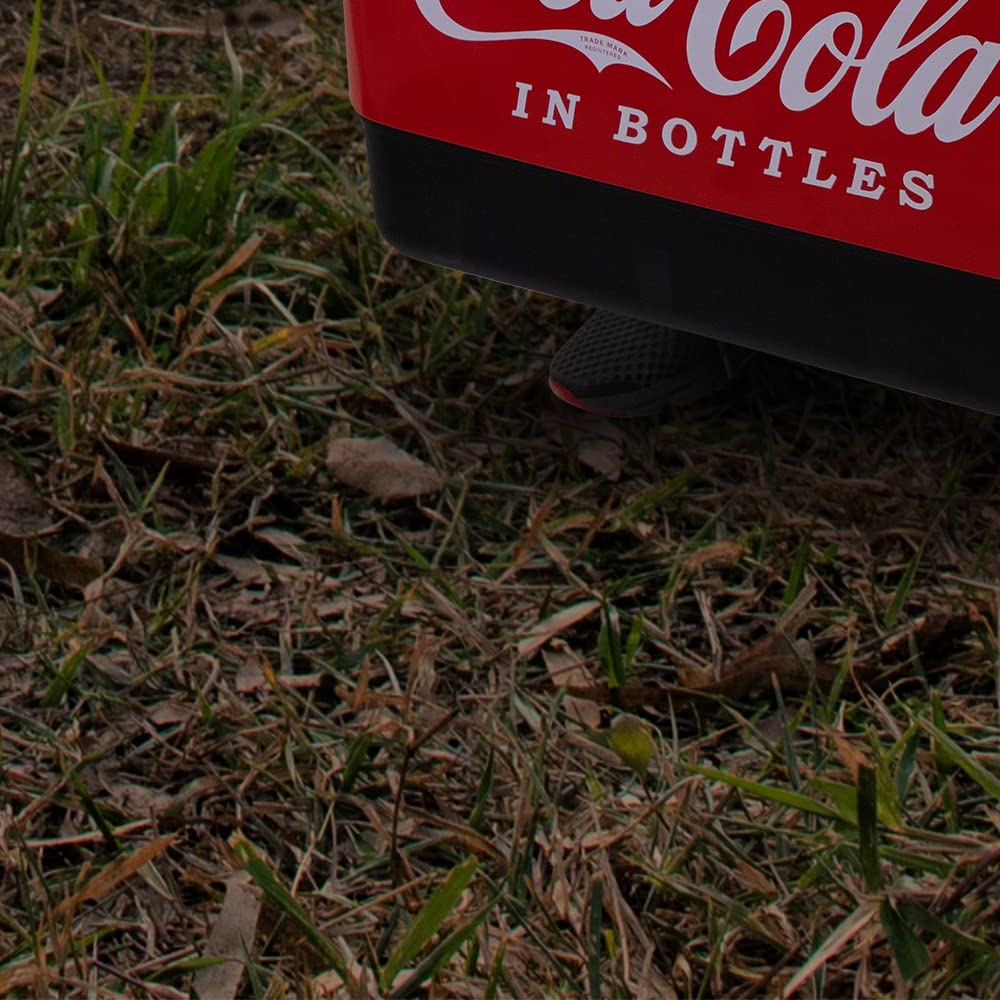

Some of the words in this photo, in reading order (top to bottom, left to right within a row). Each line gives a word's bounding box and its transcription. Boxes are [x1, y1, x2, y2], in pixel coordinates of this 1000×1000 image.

[580, 35, 604, 46] TRADE
[606, 41, 628, 57] MARK
[584, 44, 622, 60] REGISTERED
[512, 82, 580, 129] IN
[613, 105, 934, 210] BOTTLES
